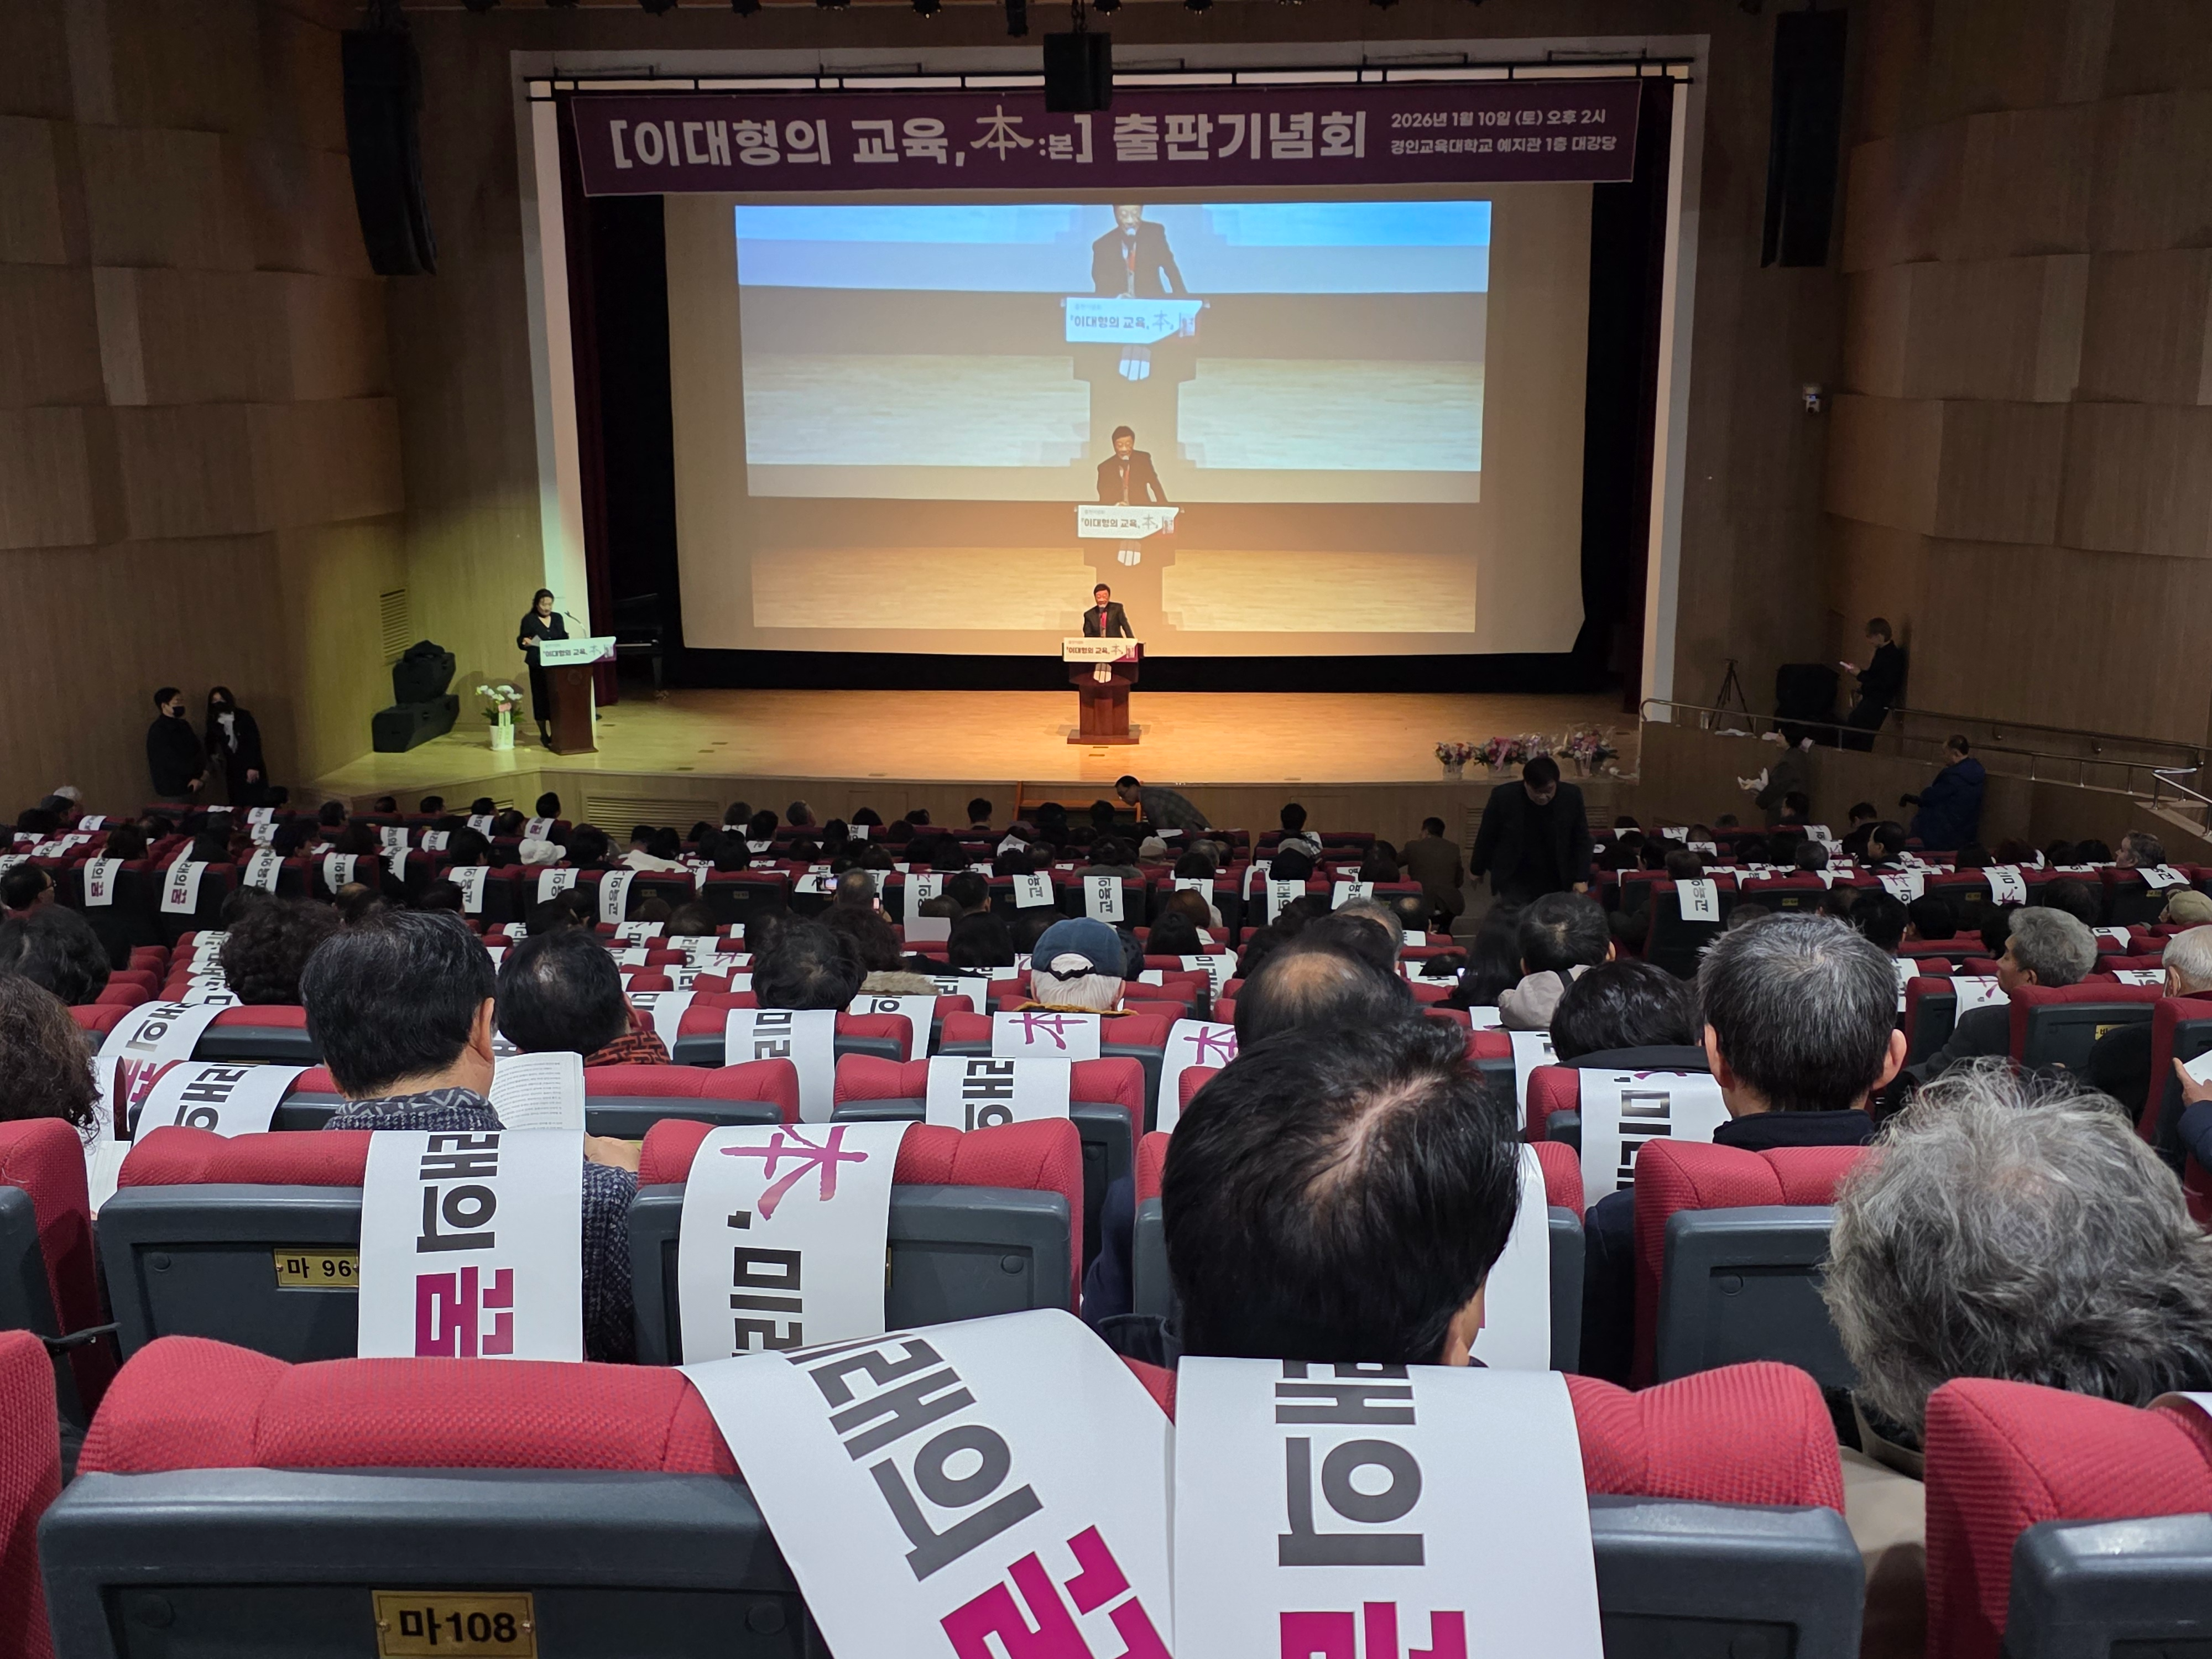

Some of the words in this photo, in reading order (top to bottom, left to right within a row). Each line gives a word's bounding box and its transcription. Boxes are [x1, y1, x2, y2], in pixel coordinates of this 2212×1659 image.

[1391, 112, 1447, 127] 2026년
[1452, 111, 1473, 126] 1월
[1478, 111, 1510, 126] 10일
[1515, 110, 1543, 126] (토)
[1547, 109, 1577, 125] 오후
[1580, 109, 1605, 124] 2시
[610, 119, 831, 169] [이대형의
[1113, 111, 1366, 161] 출판기념회
[1391, 138, 1493, 154] 경인교육대학교
[1497, 138, 1541, 152] 예지관
[1546, 137, 1567, 152] 1층
[1572, 135, 1616, 151] 대강당
[608, 875, 622, 916] 교육의
[1098, 878, 1113, 914] 교육의
[286, 1257, 310, 1279] 마
[321, 1259, 352, 1278] 96
[415, 1266, 514, 1358] 꿈
[399, 1607, 517, 1646] 마108
